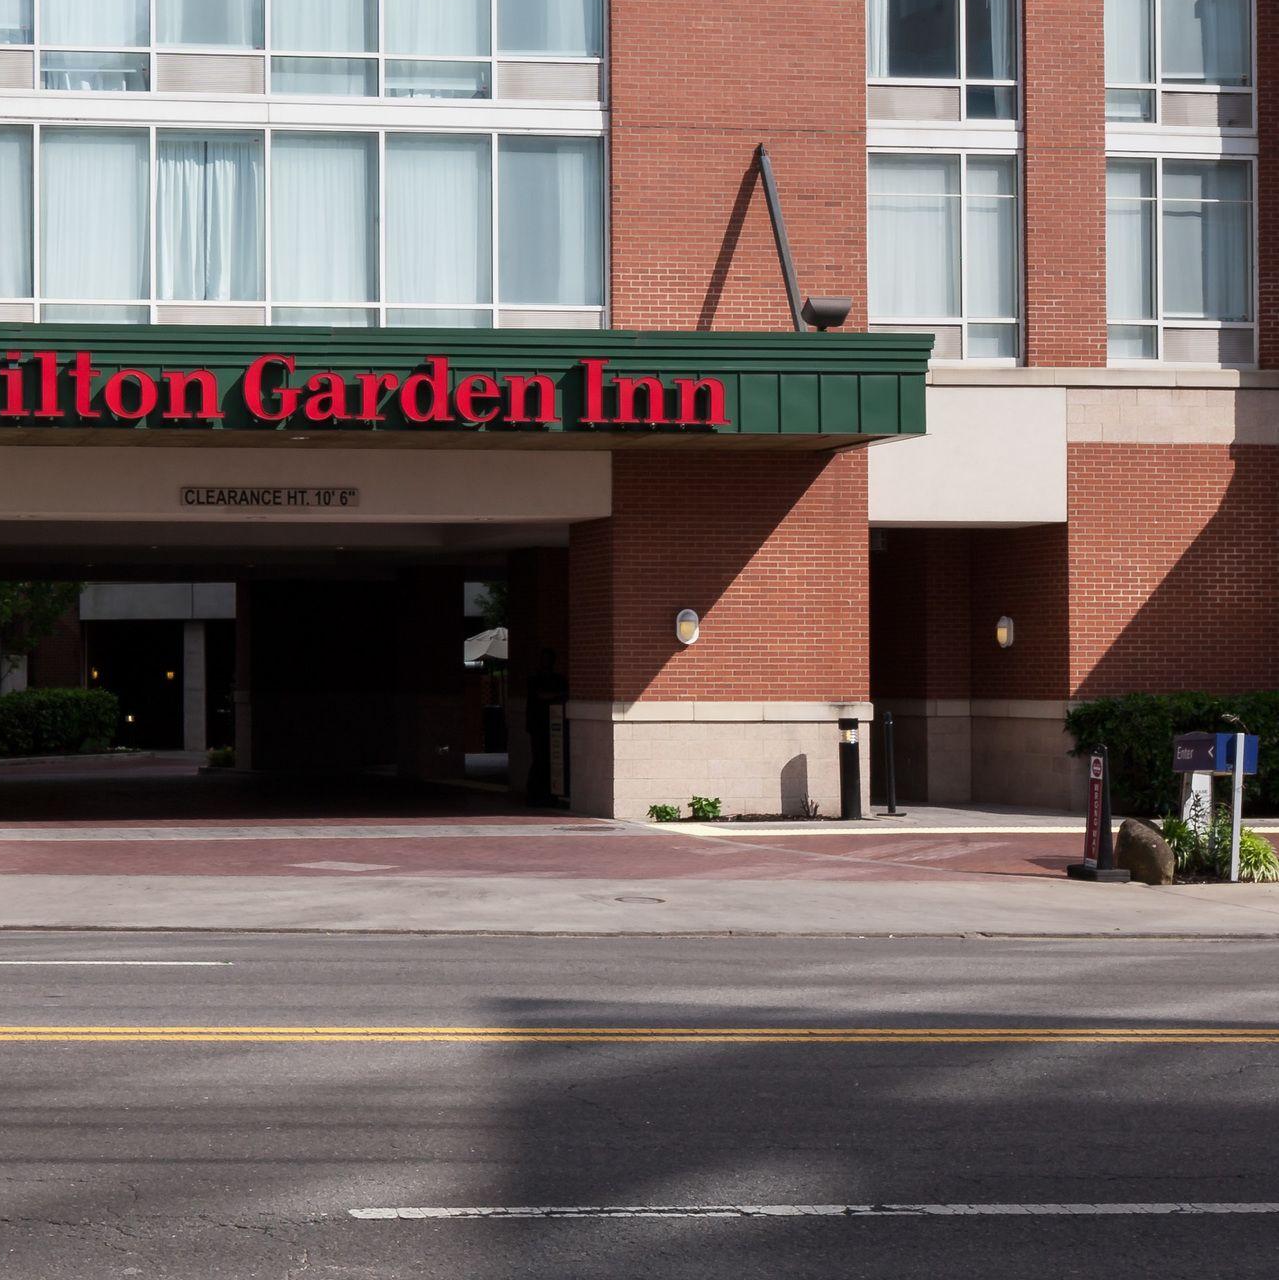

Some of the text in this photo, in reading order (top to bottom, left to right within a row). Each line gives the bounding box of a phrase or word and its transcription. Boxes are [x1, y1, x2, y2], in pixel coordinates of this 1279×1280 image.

[243, 354, 560, 424] Garden
[580, 358, 731, 426] Inn
[185, 490, 282, 505] CLEARANCE
[287, 491, 310, 505] HT.
[315, 491, 335, 506] 10'
[1176, 746, 1194, 760] Enter
